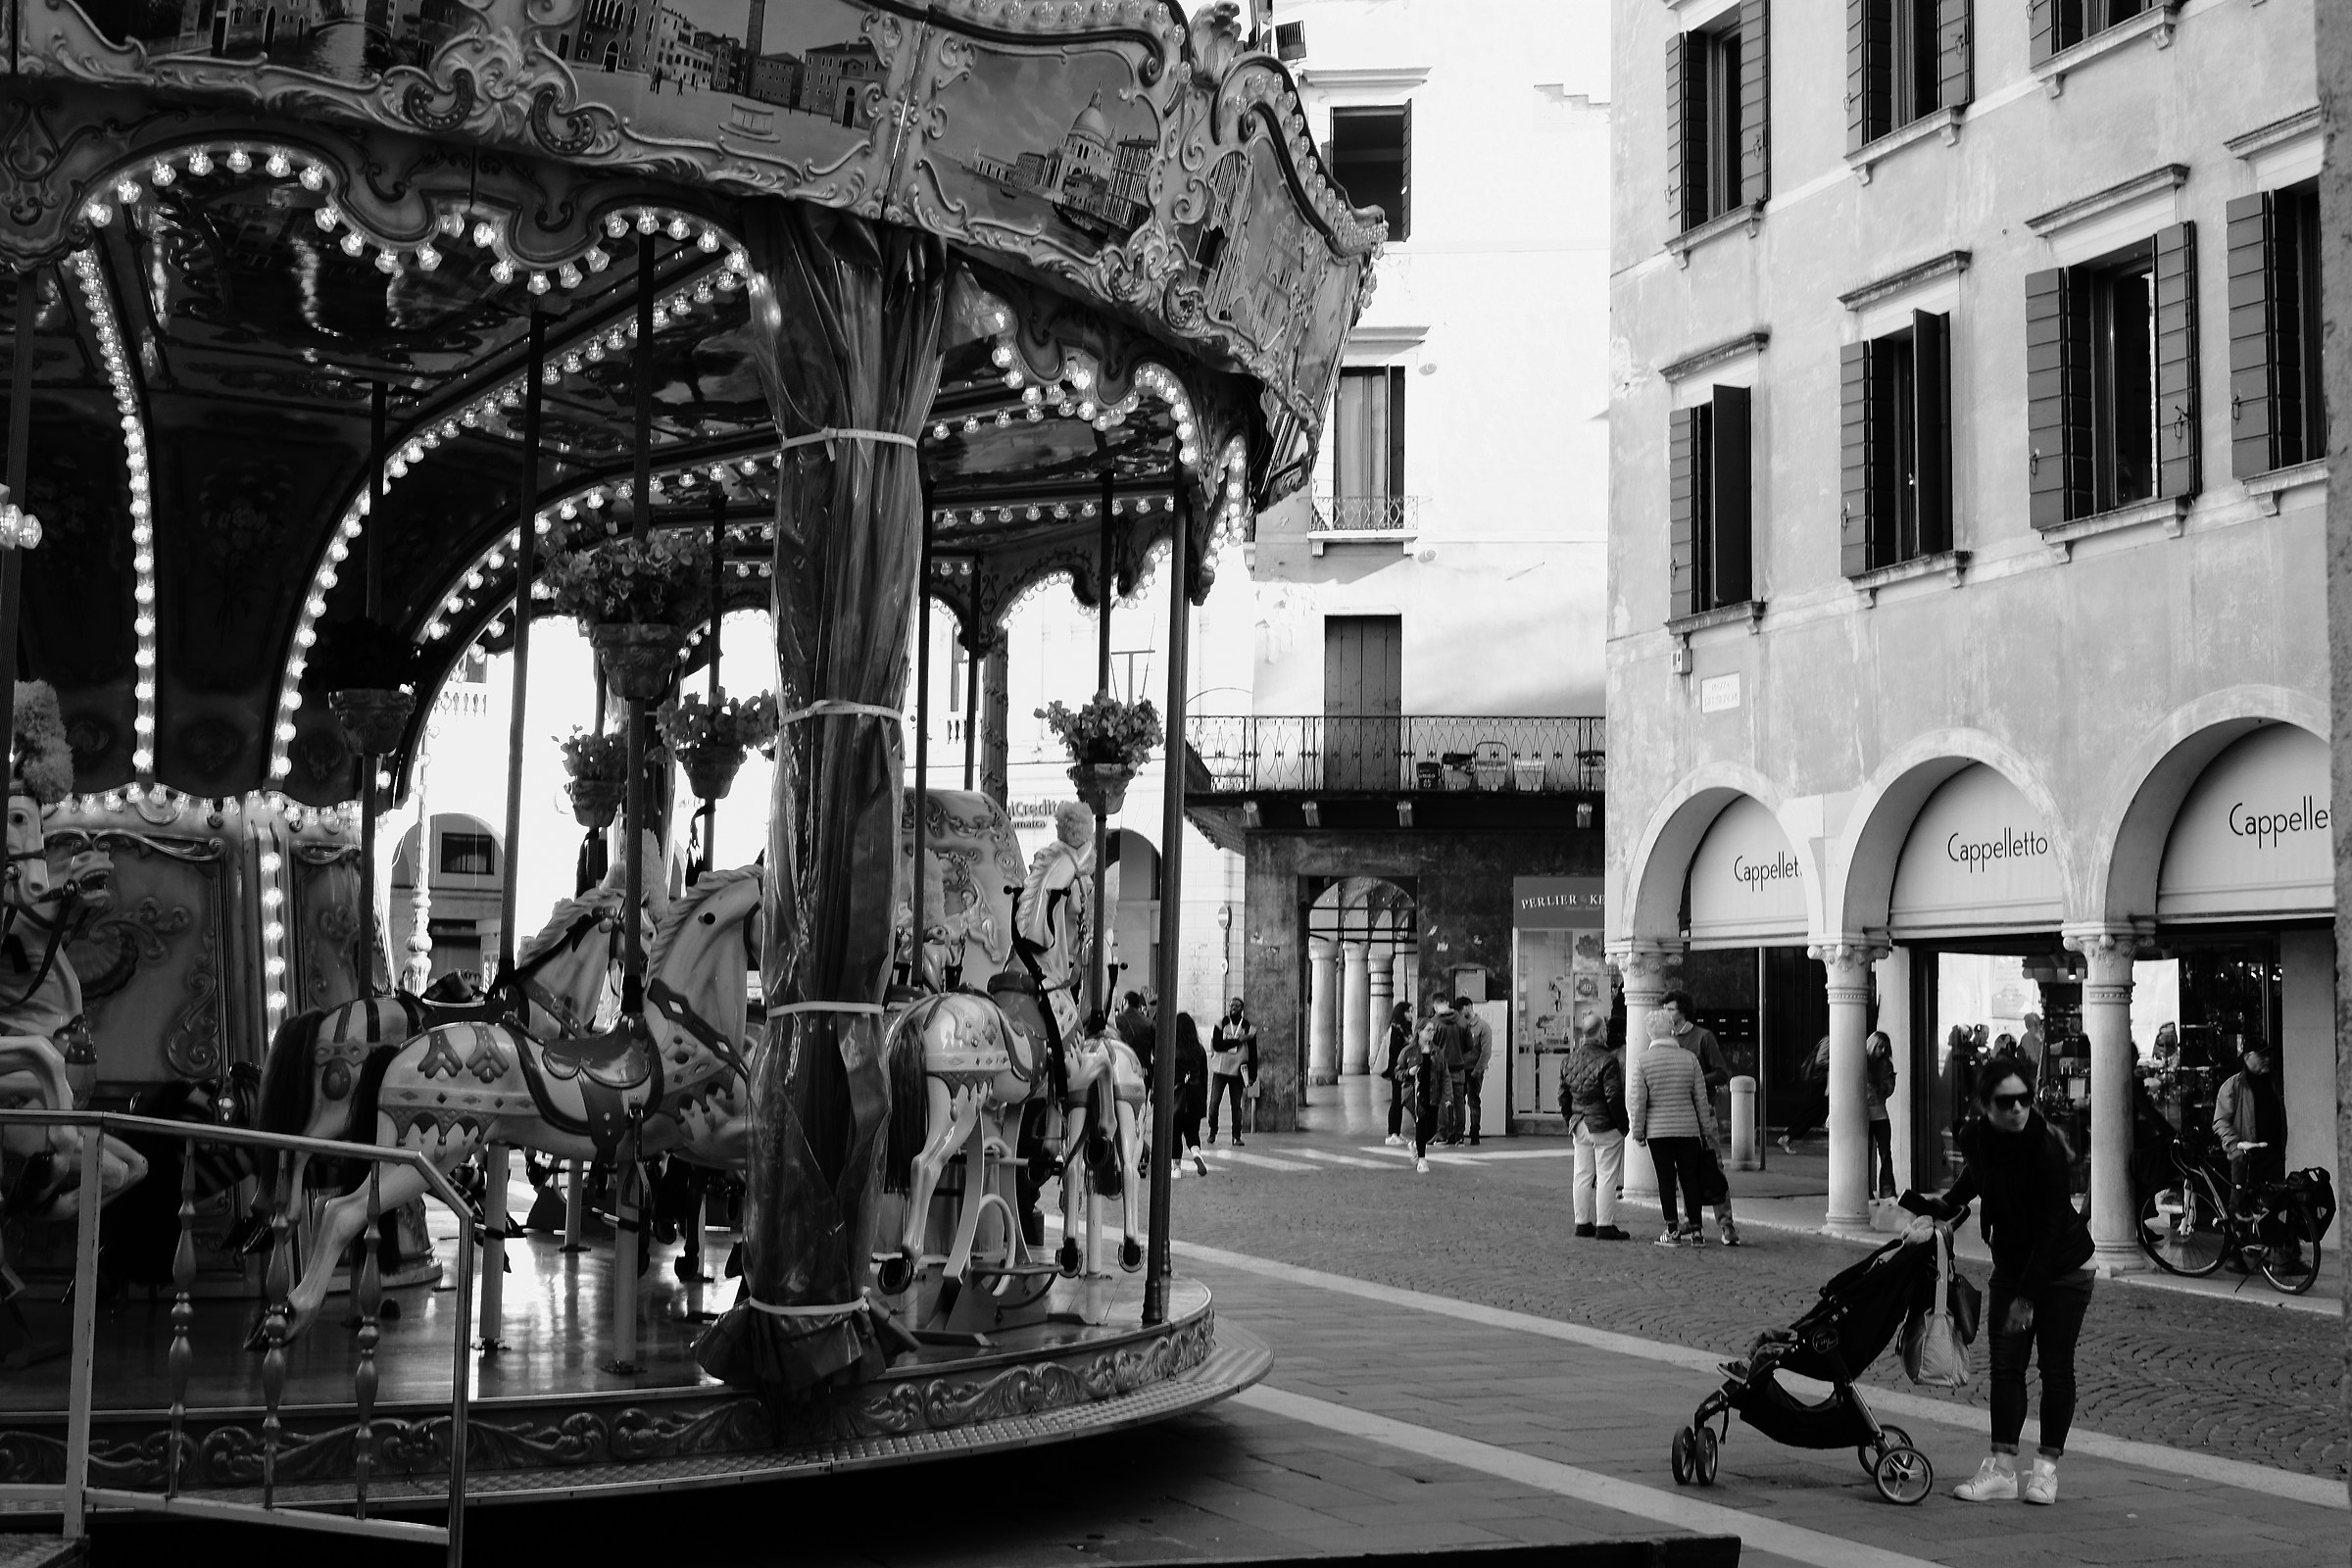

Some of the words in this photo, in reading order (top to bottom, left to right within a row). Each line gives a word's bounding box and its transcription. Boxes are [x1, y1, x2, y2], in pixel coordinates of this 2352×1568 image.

[1947, 826, 2048, 873] Cappelletto
[1734, 851, 1803, 893] Cappellet
[1521, 894, 1578, 909] PERLIER
